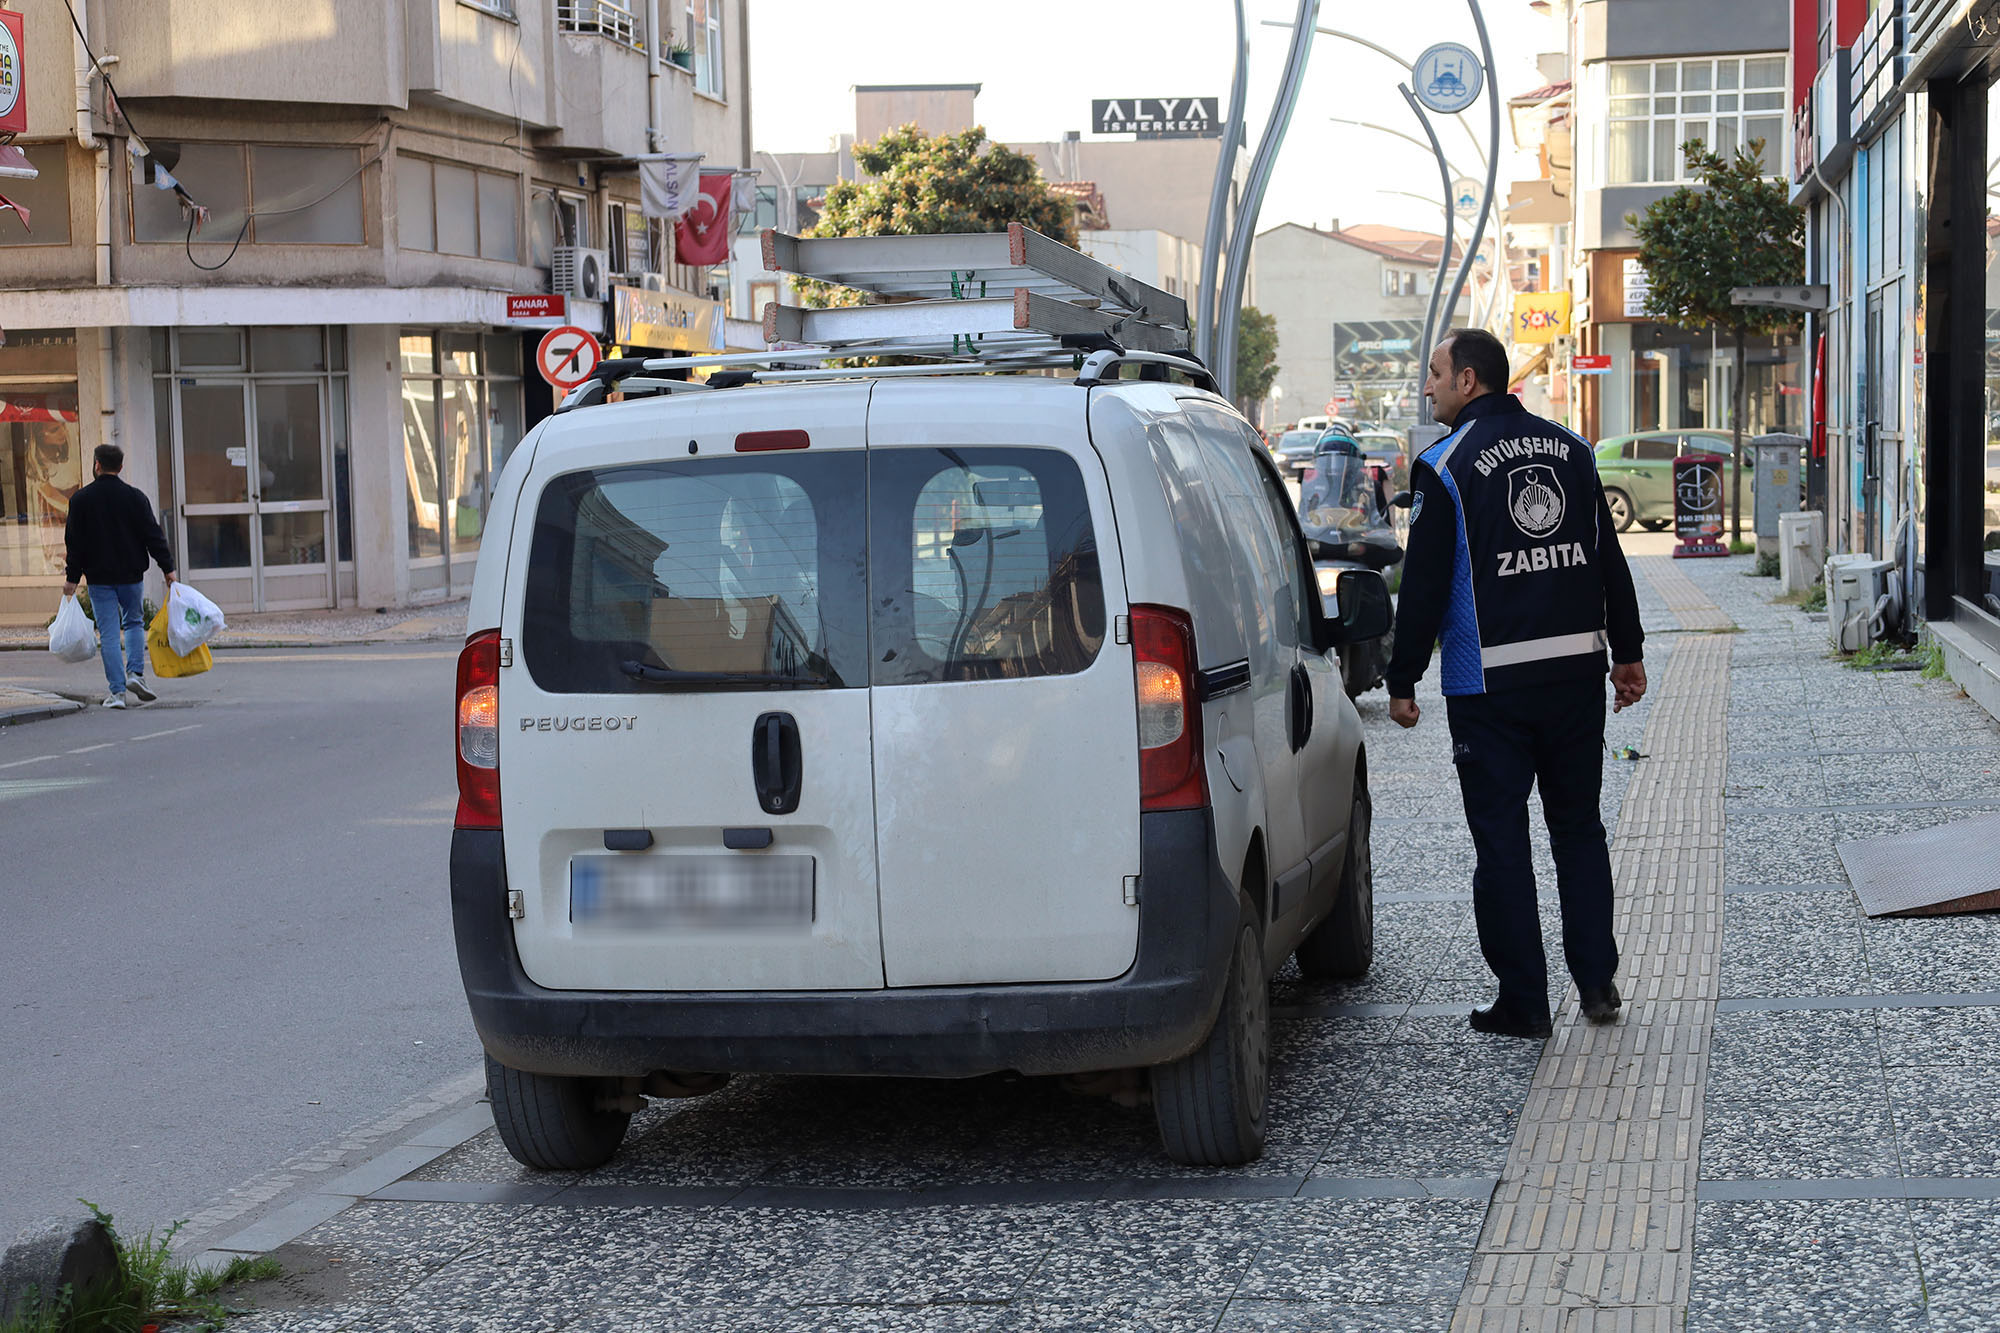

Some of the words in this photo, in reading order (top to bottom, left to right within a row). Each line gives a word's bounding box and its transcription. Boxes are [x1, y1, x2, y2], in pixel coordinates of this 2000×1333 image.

[1102, 99, 1208, 120] ALYA
[512, 299, 549, 309] KANARA
[1520, 309, 1560, 331] ŞOK
[1474, 436, 1570, 477] BÜYÜKŞEHİR
[1497, 542, 1587, 576] ZABITA
[520, 715, 637, 731] PEUGEOT
